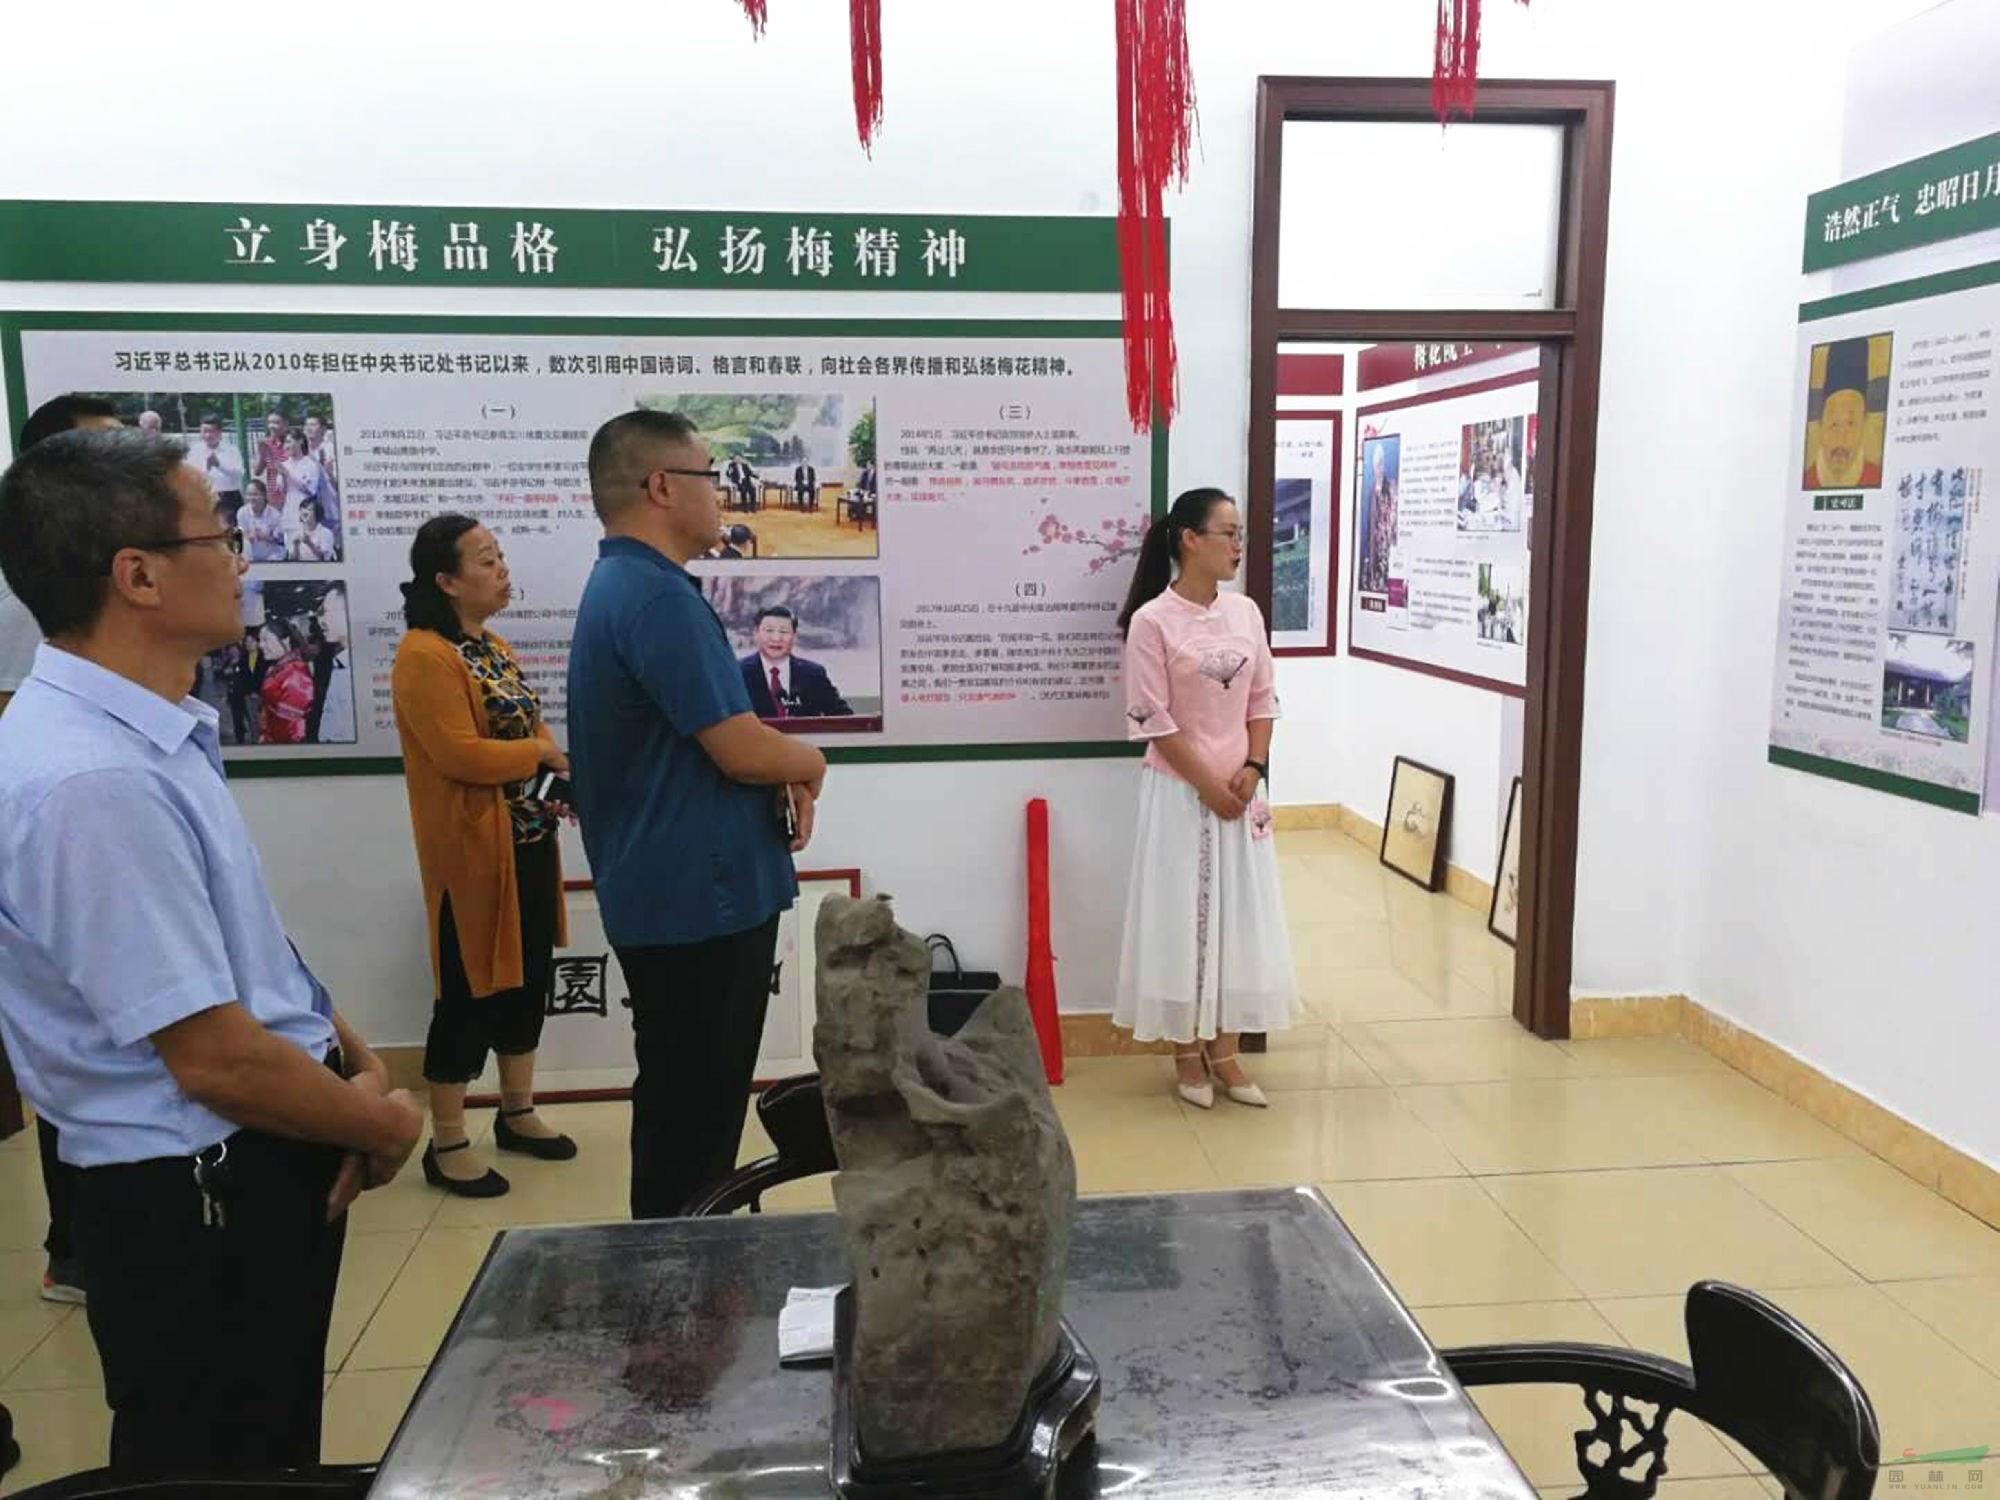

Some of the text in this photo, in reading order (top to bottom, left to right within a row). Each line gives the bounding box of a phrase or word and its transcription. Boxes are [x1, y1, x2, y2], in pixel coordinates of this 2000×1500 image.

[1824, 162, 2000, 243] 浩然正气 忠昭日月
[224, 216, 968, 279] 立身梅品格 弘扬梅精神
